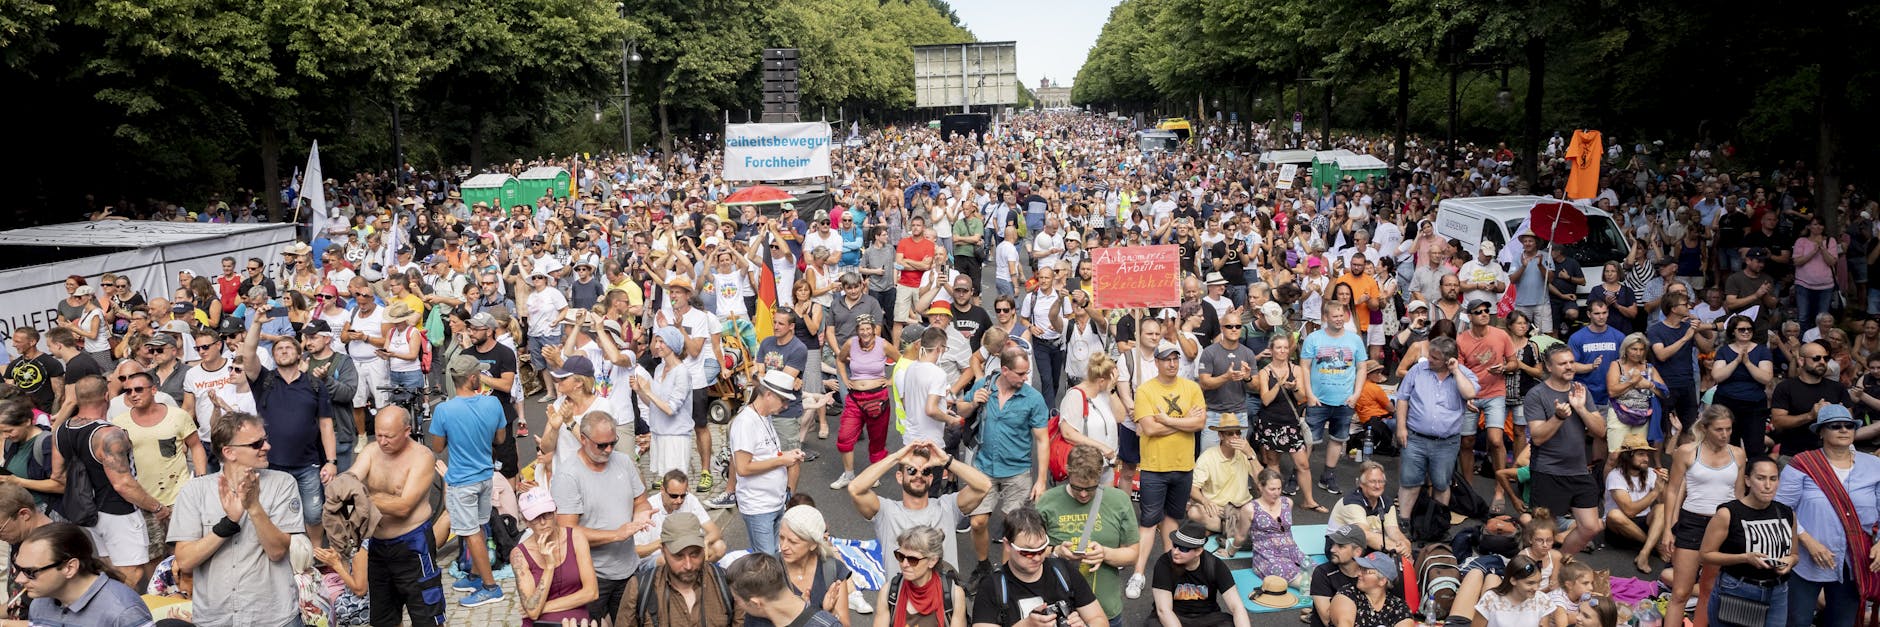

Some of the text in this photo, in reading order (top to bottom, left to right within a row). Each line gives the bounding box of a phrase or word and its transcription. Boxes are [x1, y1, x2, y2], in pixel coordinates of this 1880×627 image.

[745, 156, 810, 168] Forchheim
[195, 375, 231, 389] Wrangle
[1747, 522, 1791, 558] PUMA
